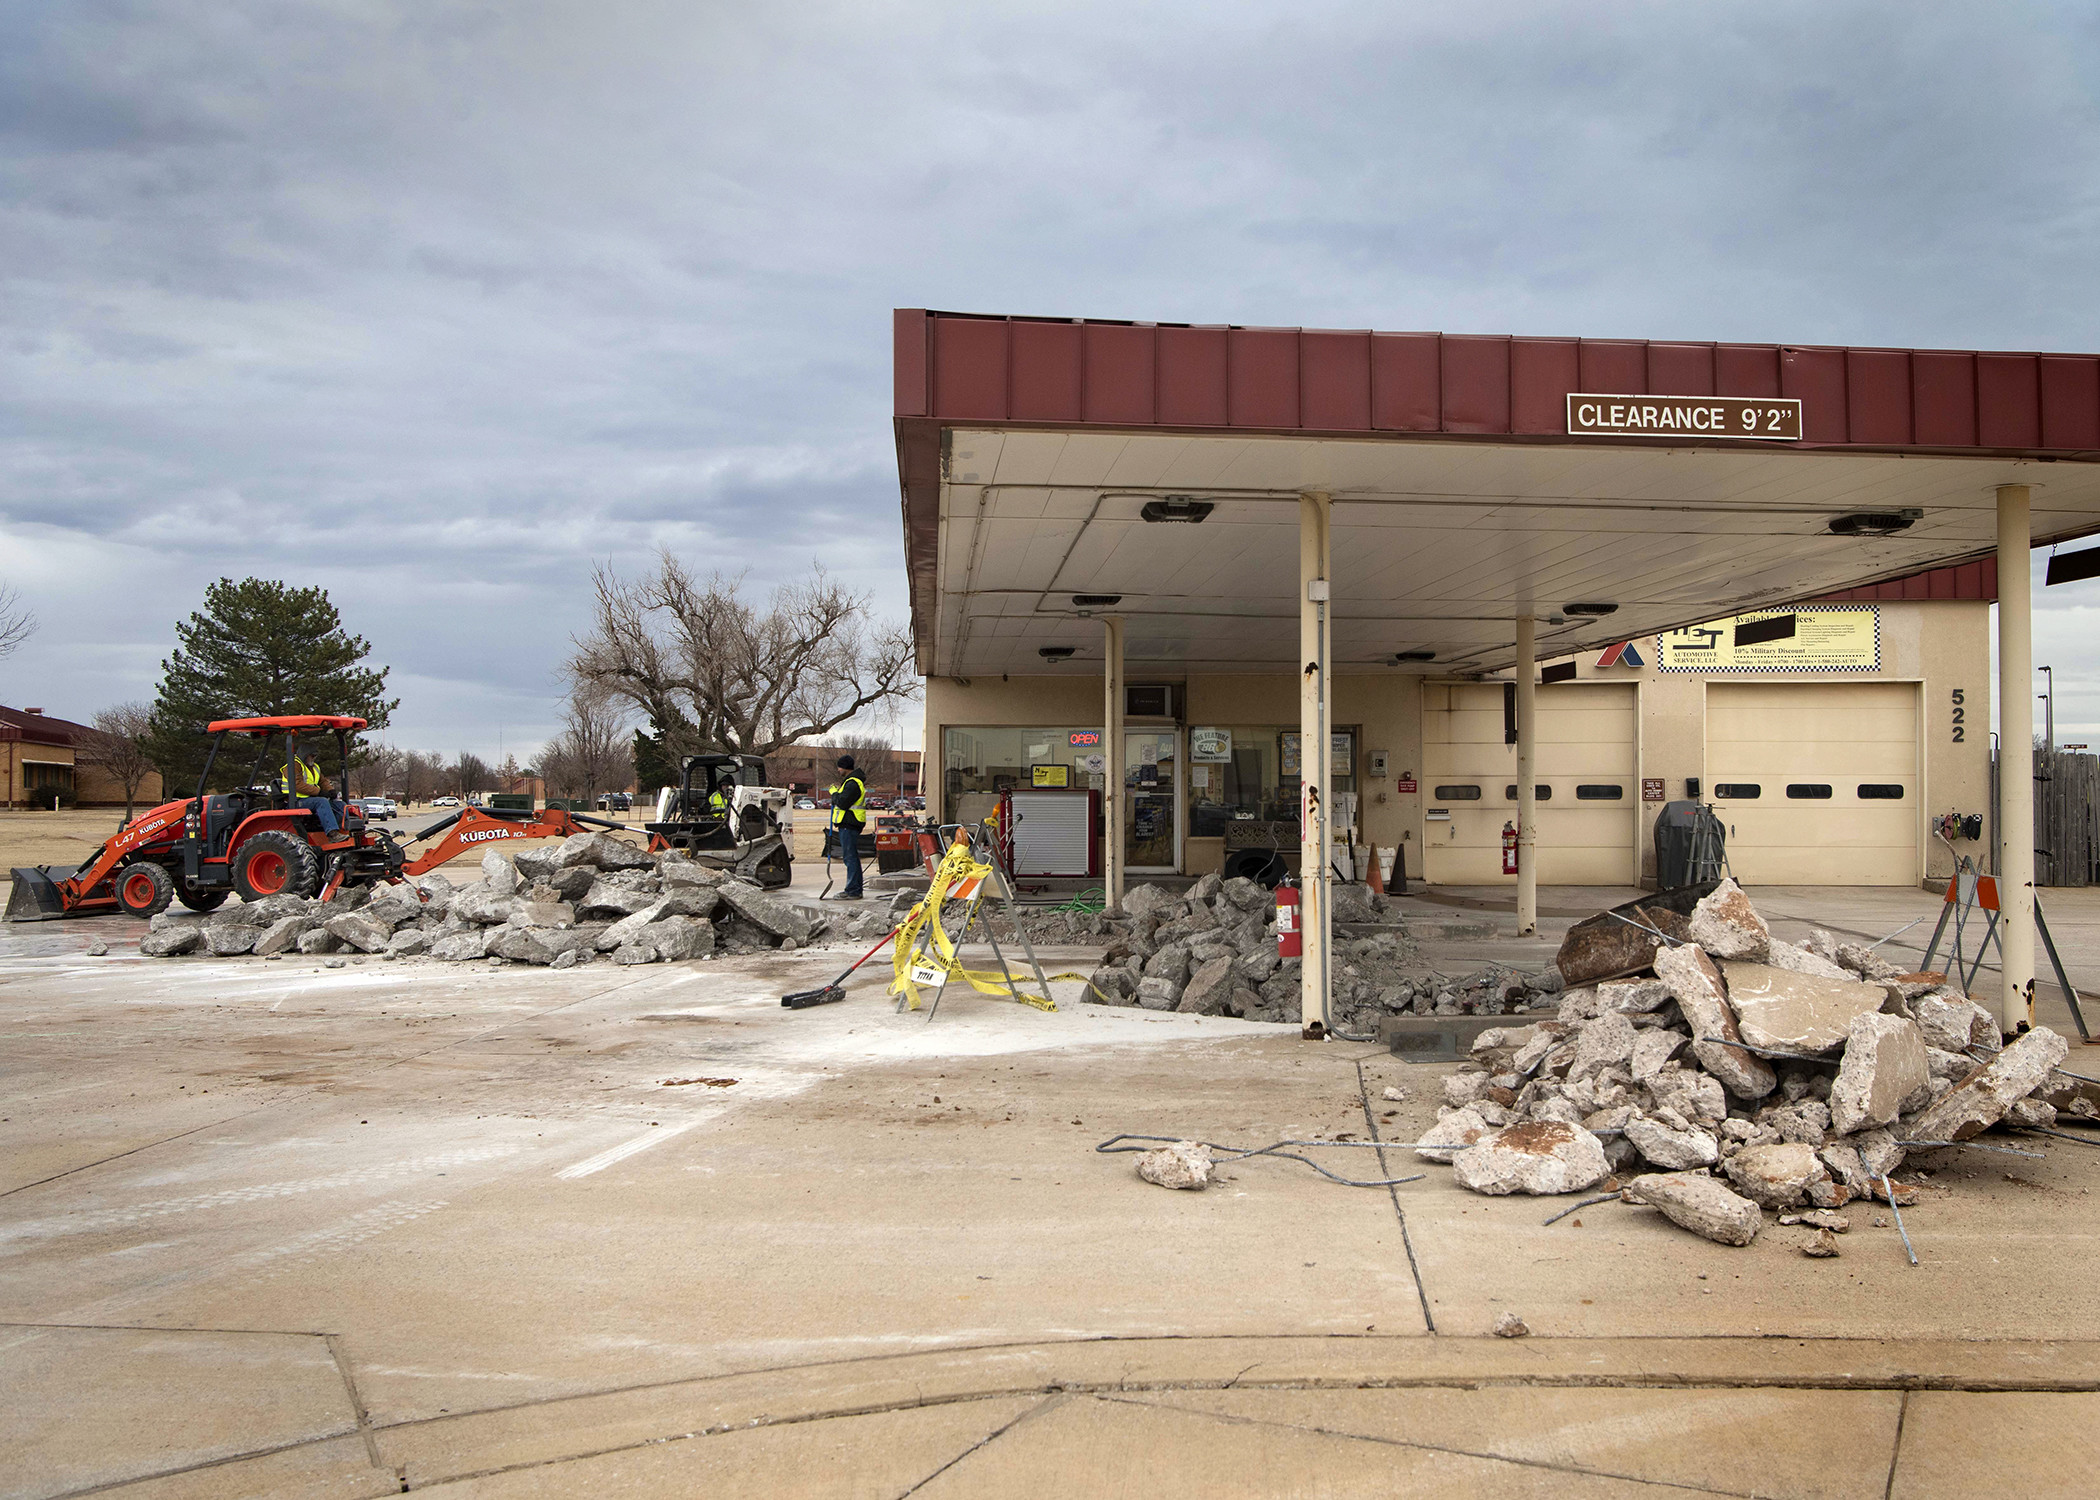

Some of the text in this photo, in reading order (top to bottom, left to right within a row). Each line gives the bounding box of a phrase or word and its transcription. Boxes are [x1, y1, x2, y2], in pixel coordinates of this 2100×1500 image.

[1578, 404, 1725, 430] CLEARANCE
[1952, 689, 1964, 742] 522
[1070, 734, 1099, 744] OPEN
[1204, 732, 1229, 742] FEATURE
[138, 819, 166, 835] KUBOTA
[115, 832, 135, 848] L47
[460, 828, 510, 843] KUBOTA
[917, 971, 934, 981] TITAN
